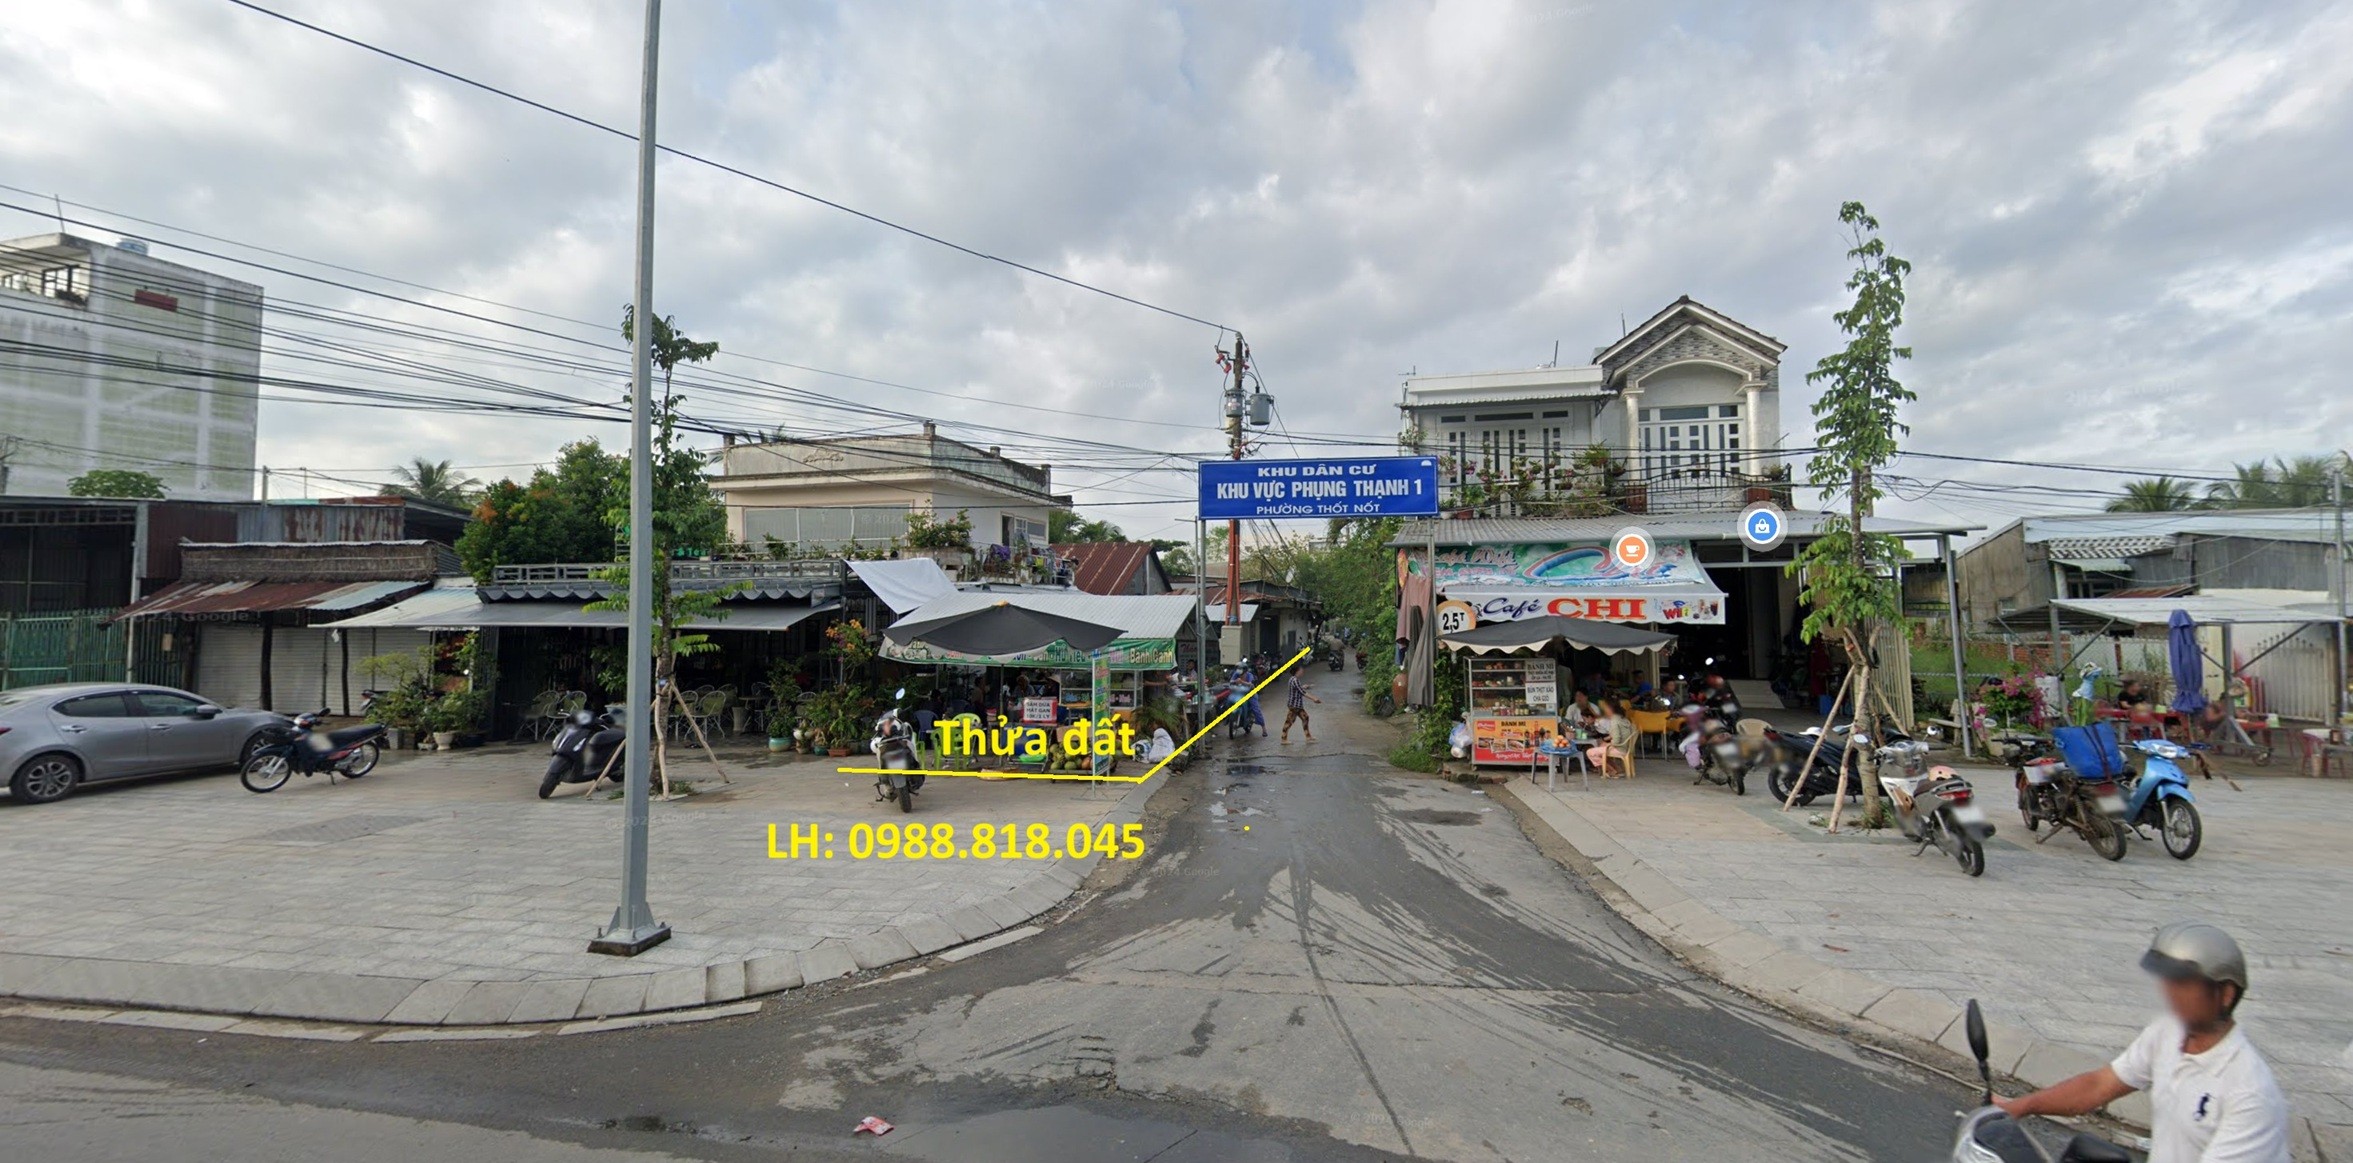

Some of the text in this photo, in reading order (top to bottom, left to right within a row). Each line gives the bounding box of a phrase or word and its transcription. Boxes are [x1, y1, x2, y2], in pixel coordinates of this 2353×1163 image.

[1258, 463, 1376, 477] KHU DÂN CƯ
[1217, 479, 1422, 502] KHU VỰC PHỤNG THẠNH 1
[1256, 501, 1381, 515] PHƯỜNG THỐT NỐT
[1483, 597, 1647, 620] Café CHI
[1152, 647, 1173, 664] Canh
